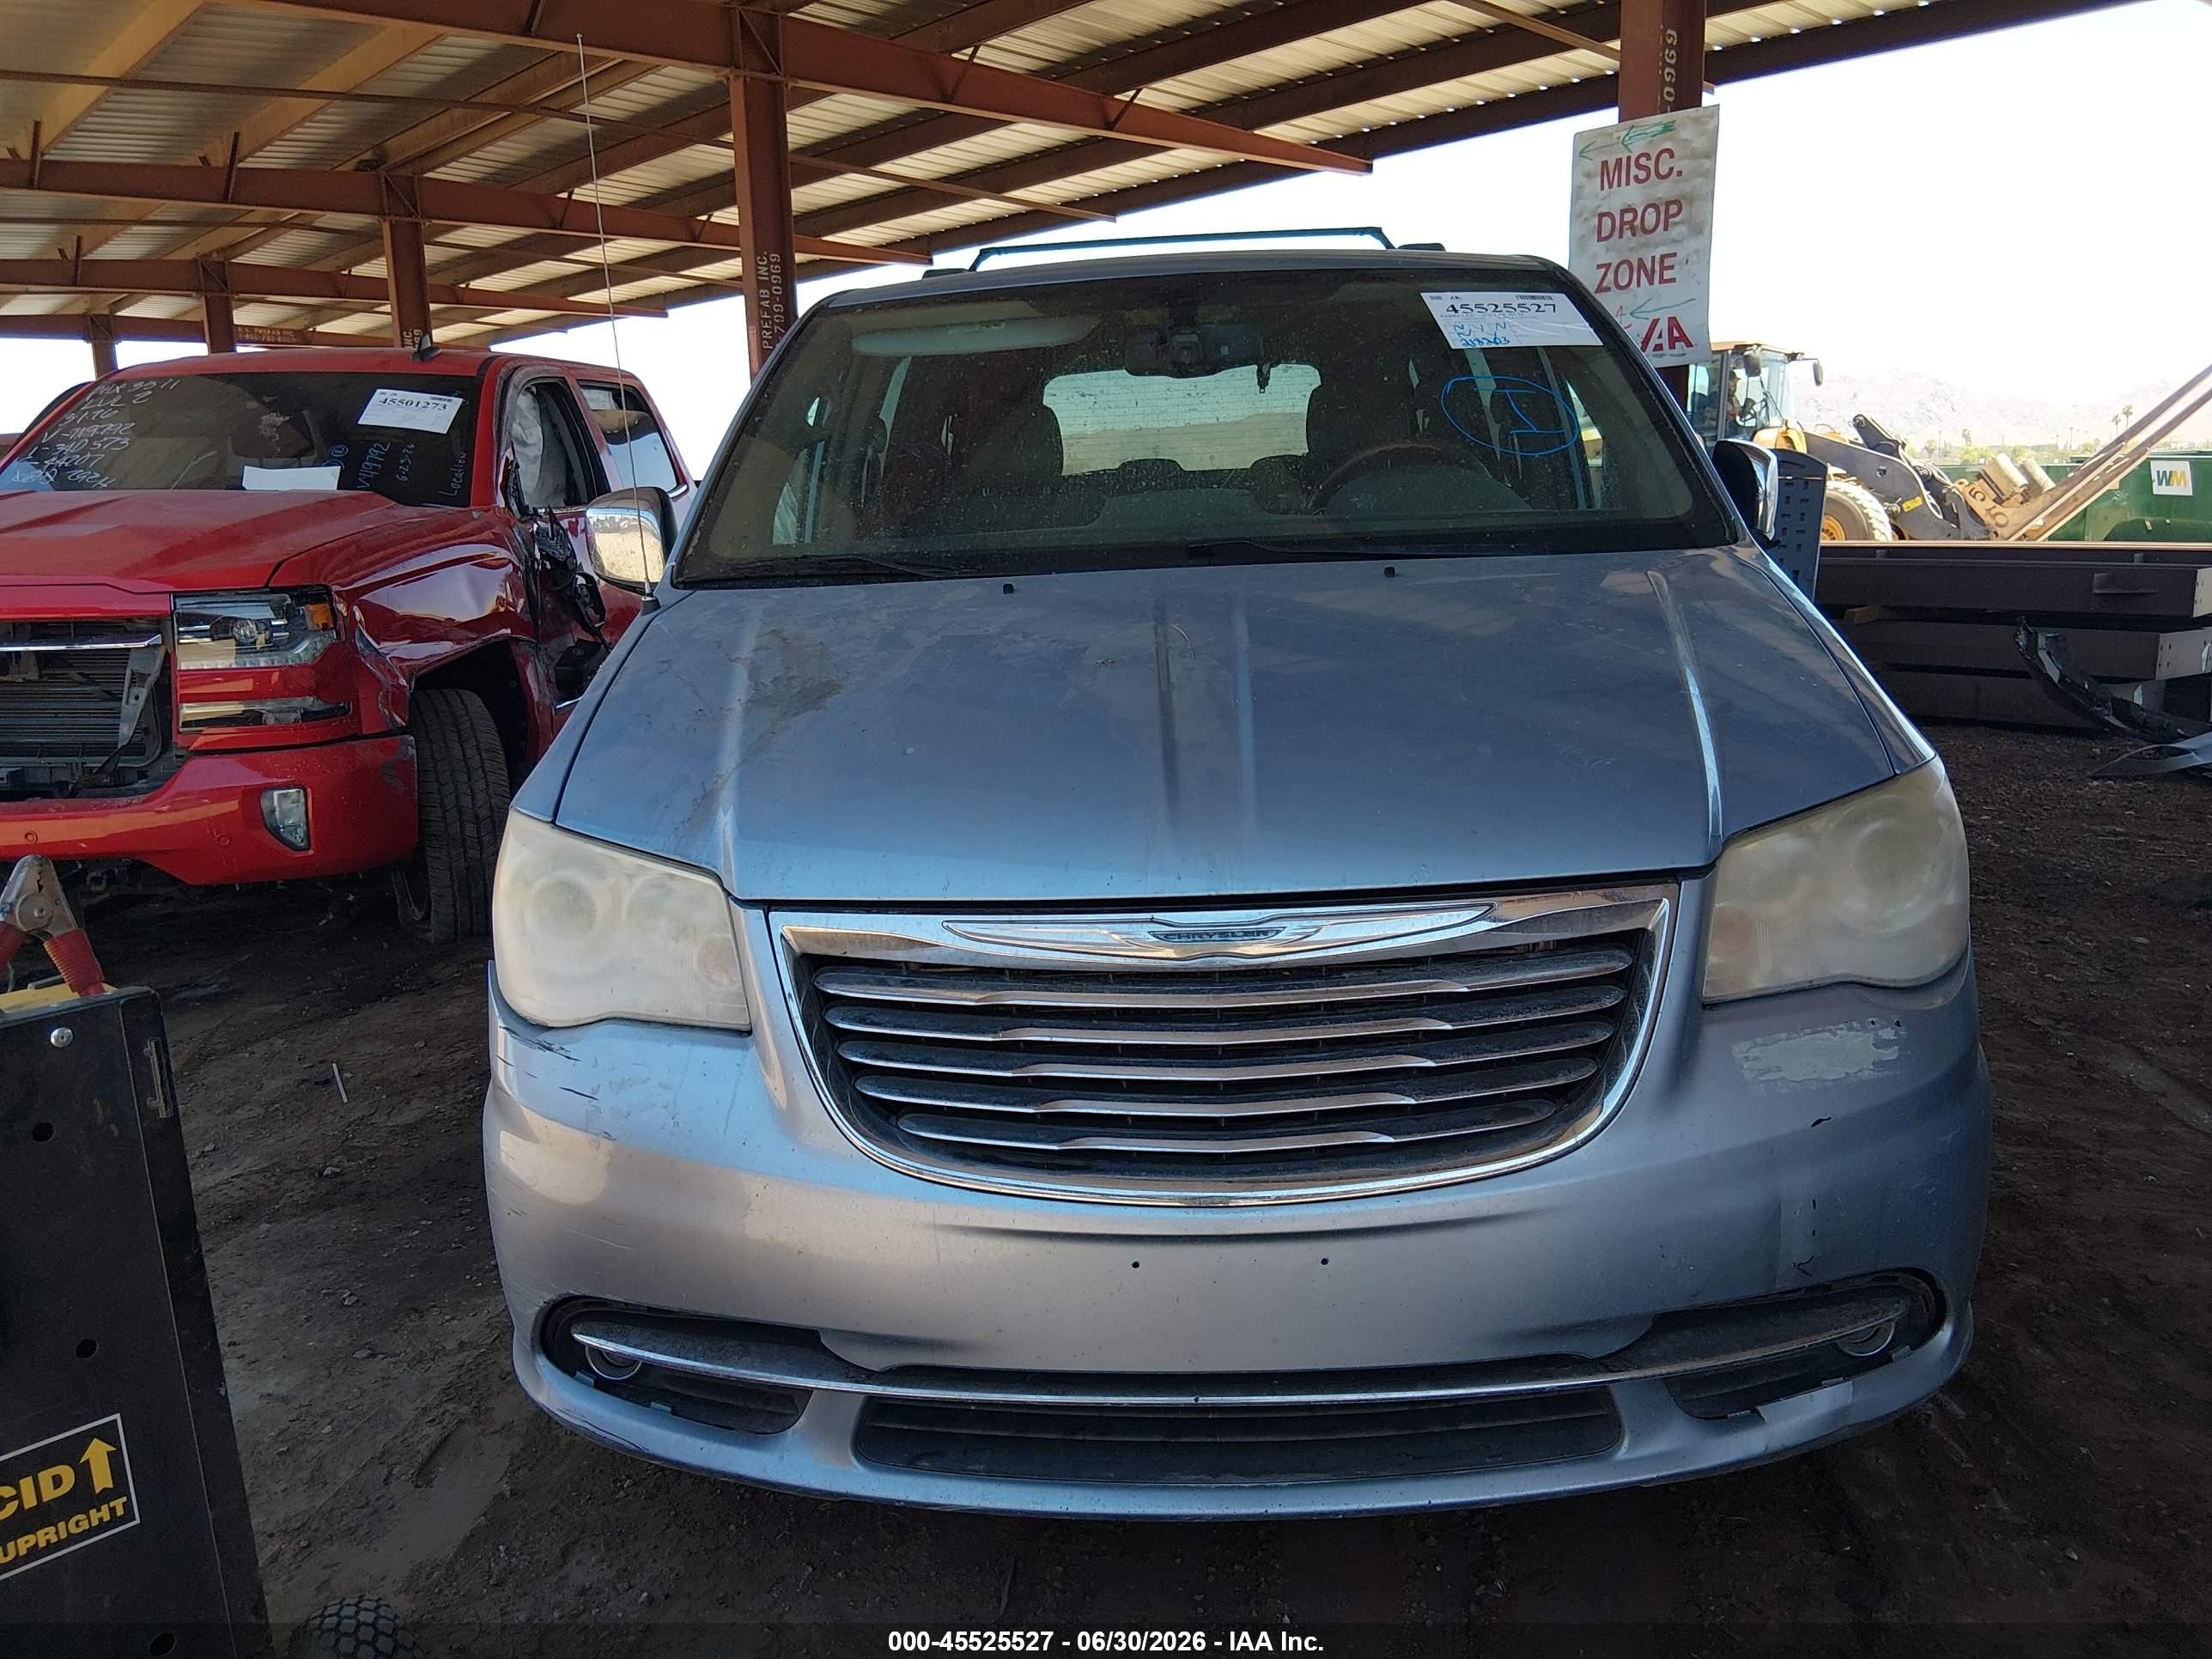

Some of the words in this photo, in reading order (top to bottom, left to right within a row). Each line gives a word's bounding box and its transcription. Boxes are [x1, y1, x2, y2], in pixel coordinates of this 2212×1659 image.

[1599, 148, 1683, 191] MISC.
[1596, 199, 1684, 242] DROP
[757, 251, 770, 280] INC.
[1594, 252, 1677, 294] ZONE
[759, 289, 774, 349] PREFAB
[1445, 303, 1557, 314] 45525527
[379, 397, 448, 412] 45501273
[2156, 470, 2188, 488] WM
[1164, 930, 1269, 940] CHRYSLER
[0, 1496, 128, 1564] UPRIGHT
